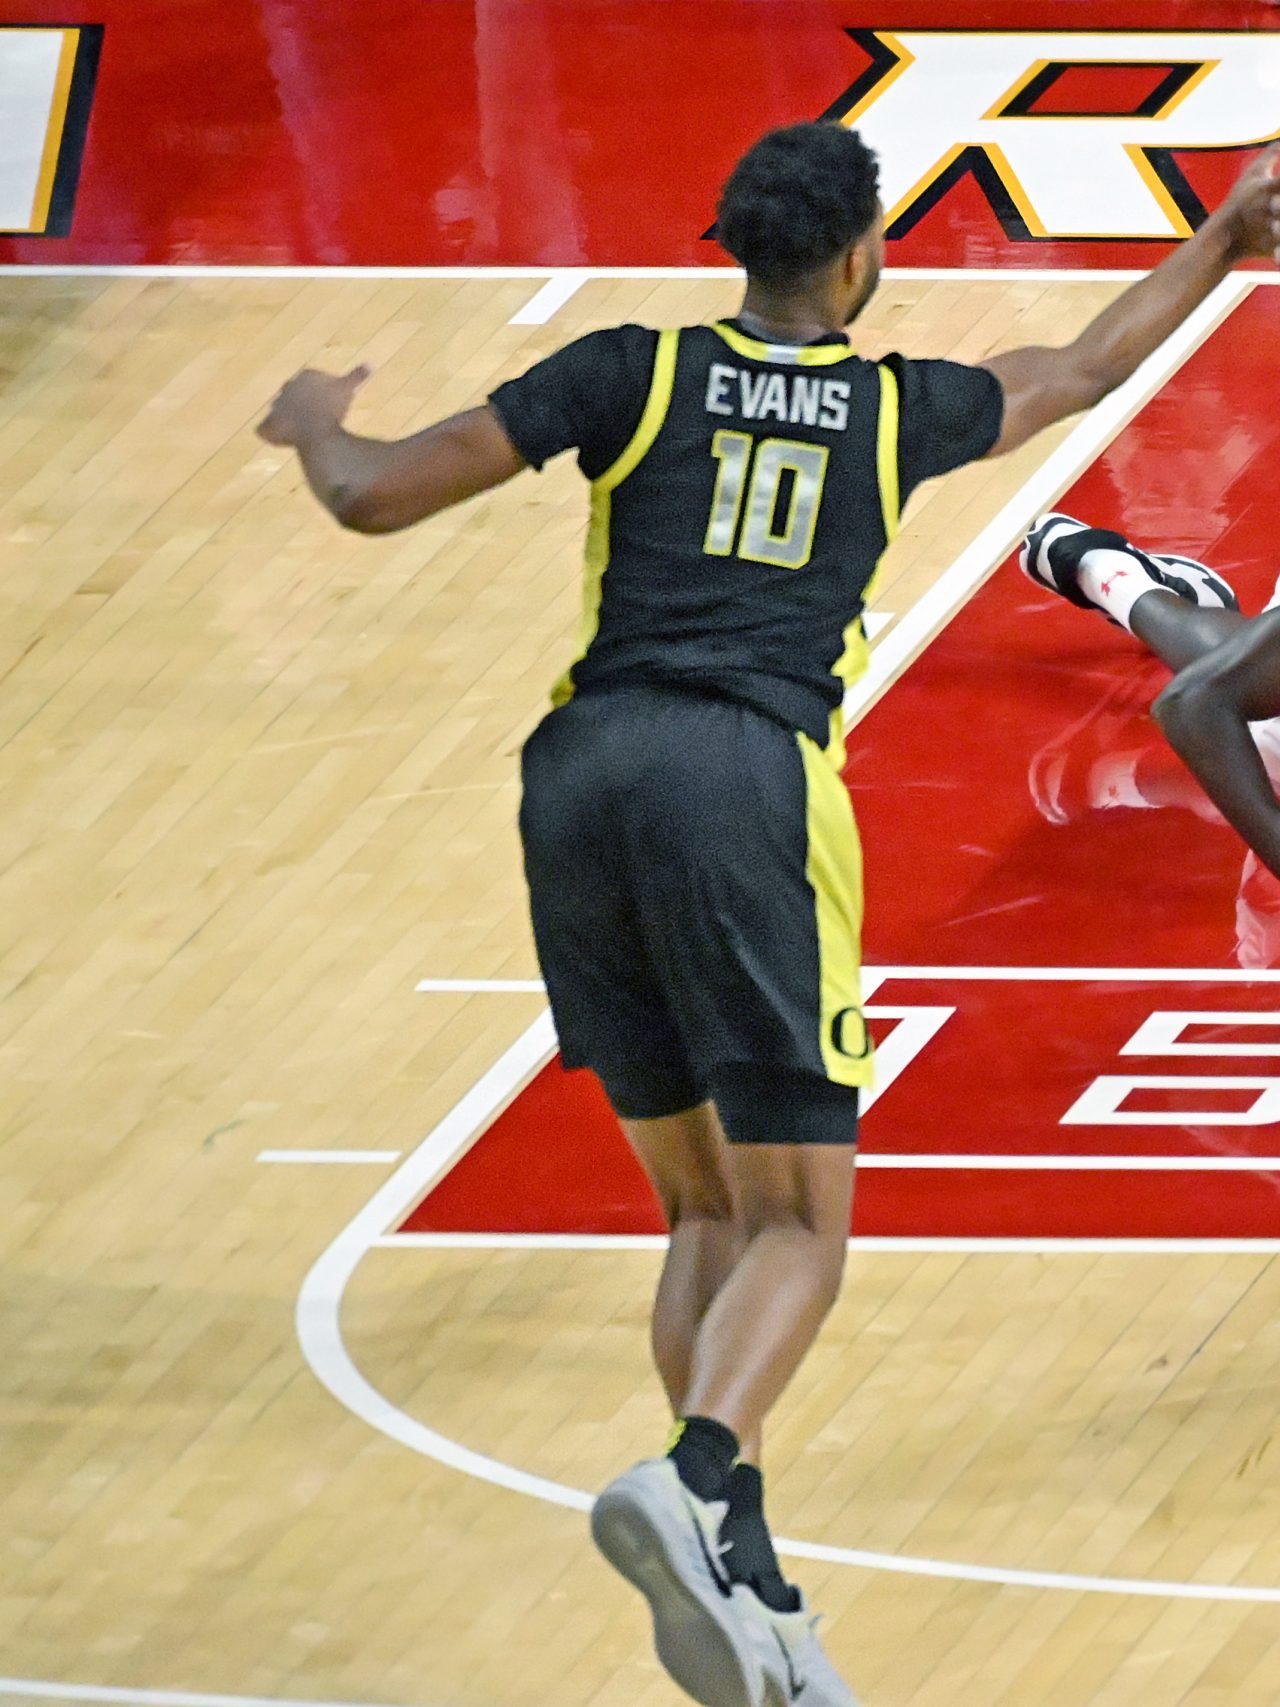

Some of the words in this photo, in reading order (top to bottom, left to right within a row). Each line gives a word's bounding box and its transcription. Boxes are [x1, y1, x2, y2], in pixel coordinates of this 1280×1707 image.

[705, 363, 851, 431] EVANS
[703, 428, 830, 570] 10
[831, 1006, 870, 1060] O
